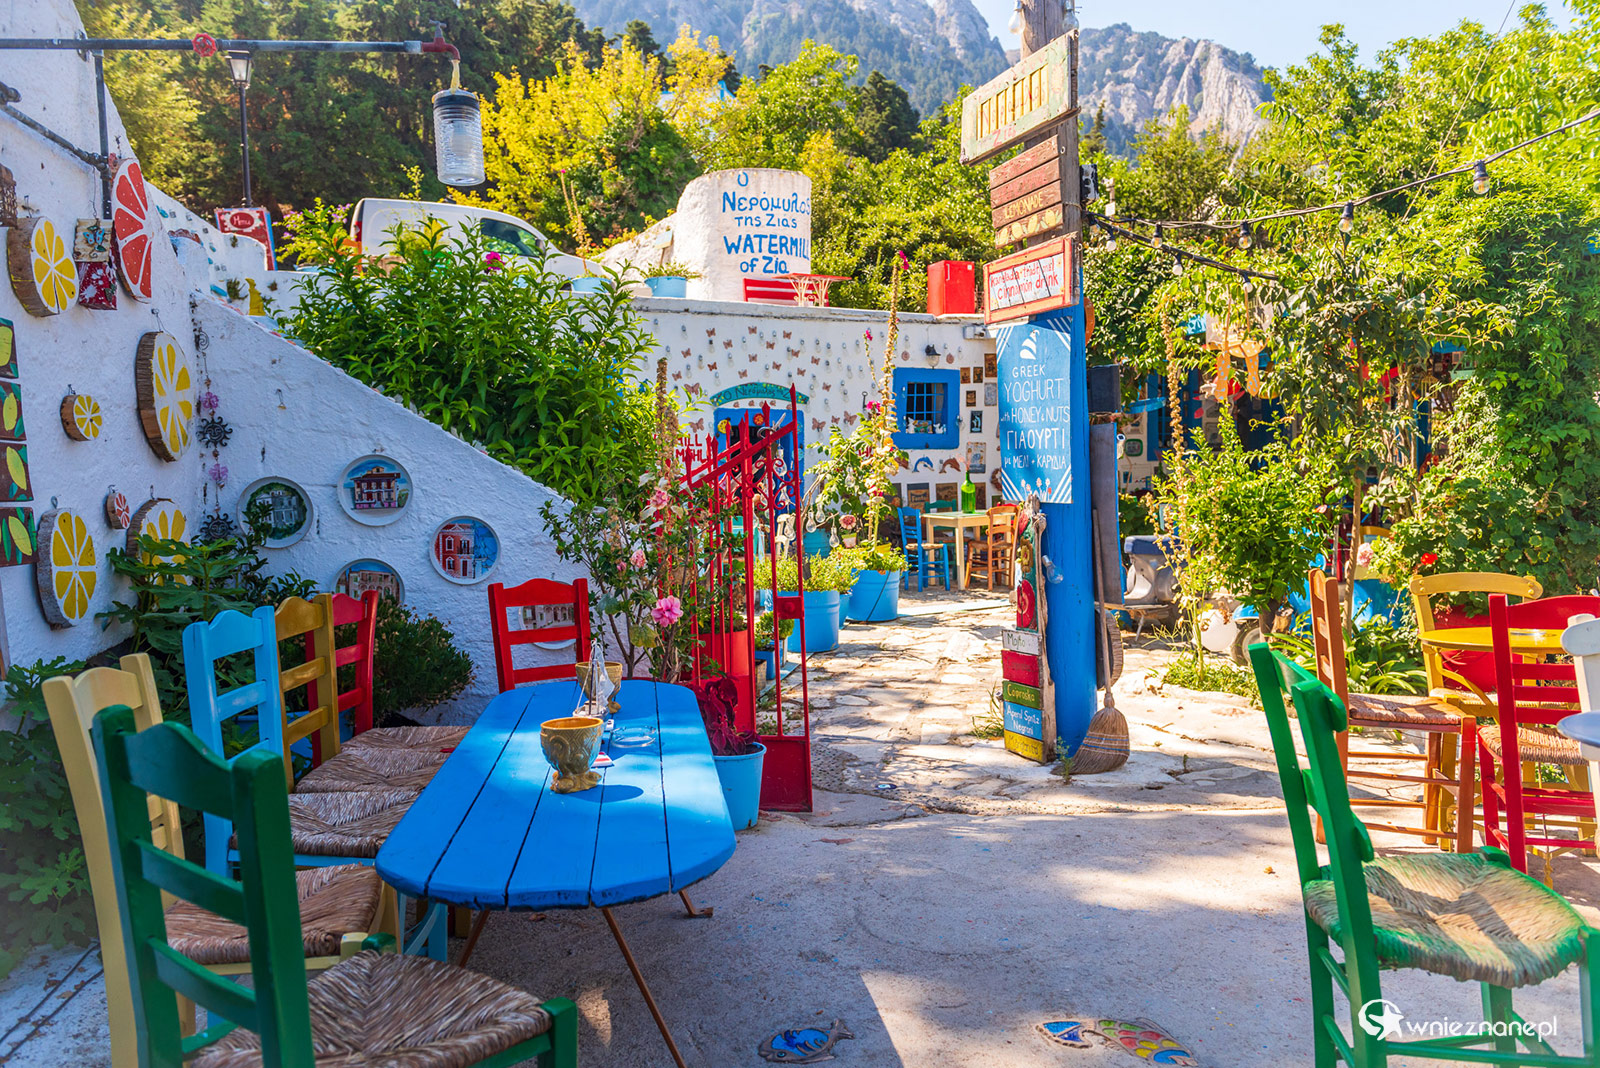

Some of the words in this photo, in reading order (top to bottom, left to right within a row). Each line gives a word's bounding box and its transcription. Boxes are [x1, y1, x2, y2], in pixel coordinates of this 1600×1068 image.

[1004, 192, 1043, 219] LEMONADE
[723, 233, 810, 260] WATERMILL
[740, 257, 759, 273] of
[762, 255, 790, 274] Zia
[1035, 273, 1059, 289] drink
[1012, 364, 1046, 378] GREEK
[1003, 378, 1064, 403] YOGHURT
[1011, 406, 1041, 423] HONEY
[1046, 405, 1071, 423] NUTS
[1006, 428, 1066, 450] ΓΙΑΟΥΡΤΙ
